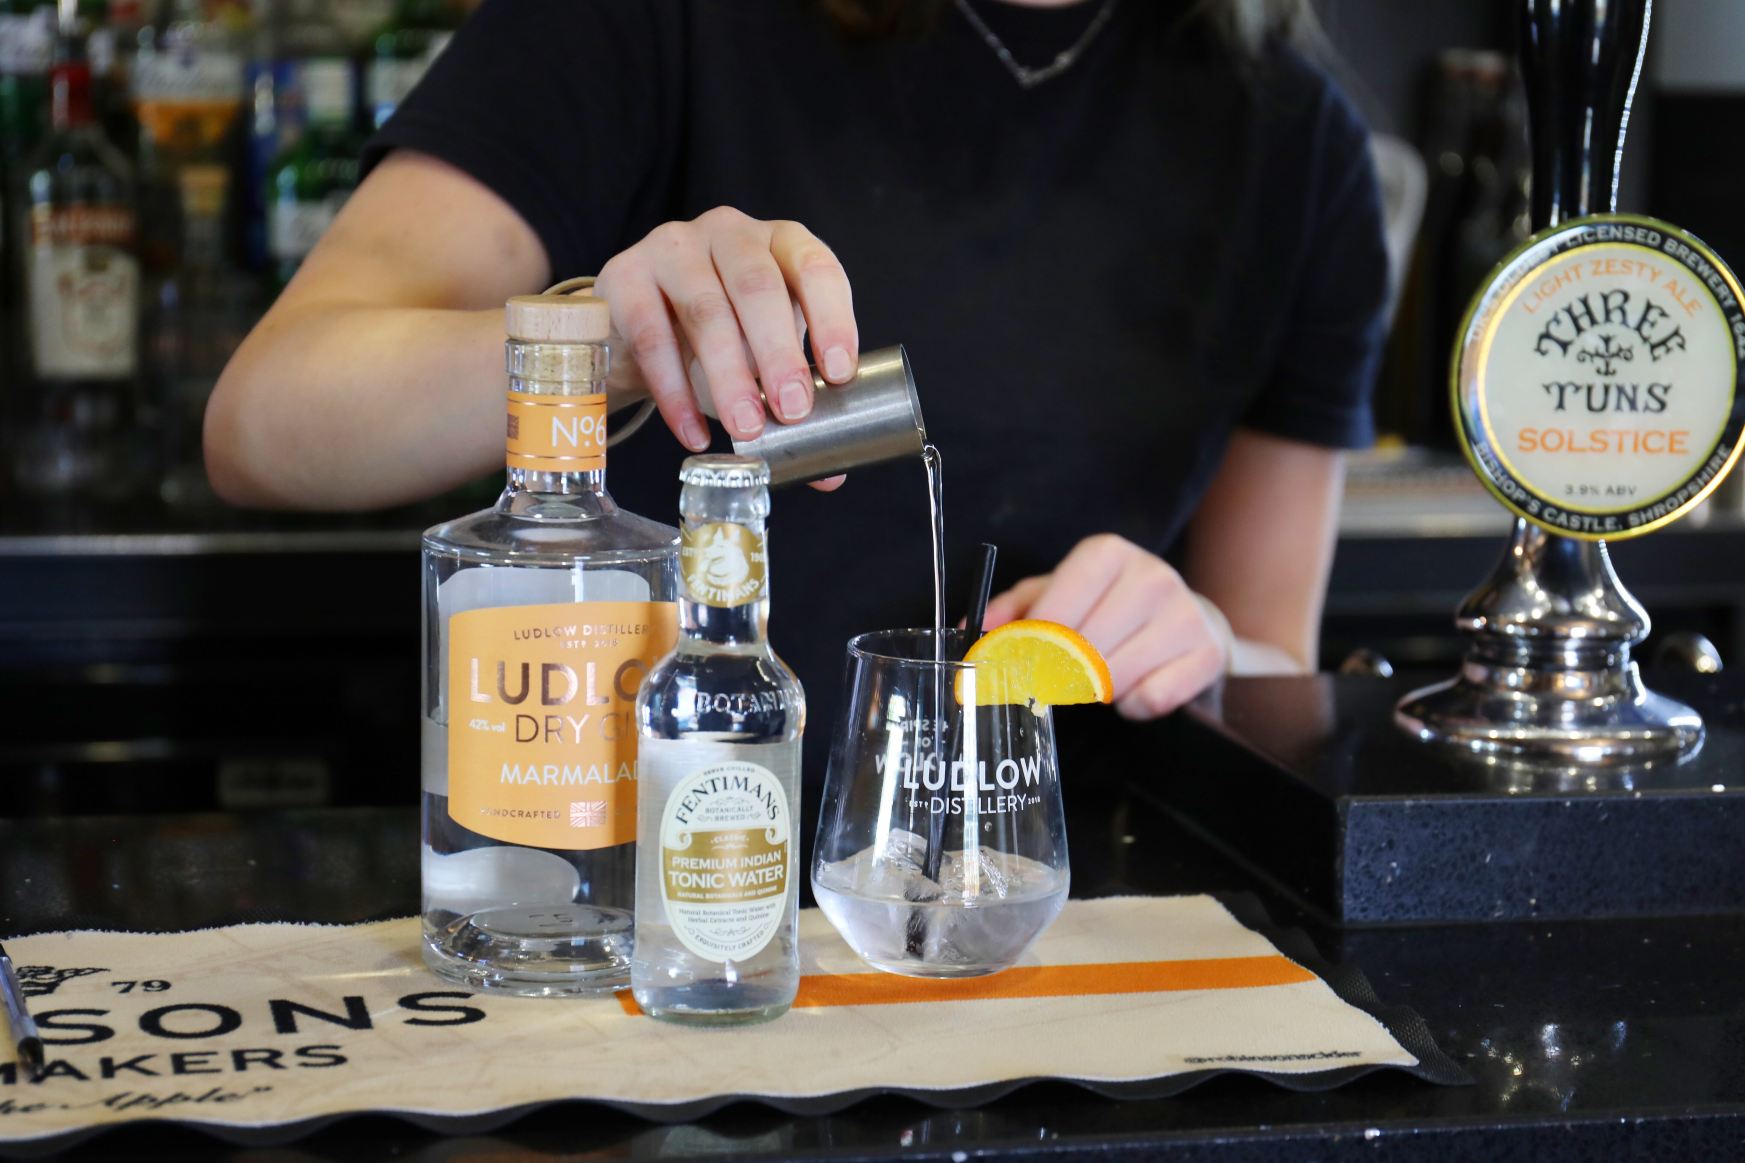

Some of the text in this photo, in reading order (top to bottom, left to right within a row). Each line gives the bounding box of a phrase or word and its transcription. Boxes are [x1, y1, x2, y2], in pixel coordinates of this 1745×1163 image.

[1566, 226, 1661, 248] LICENSED
[1664, 238, 1736, 307] BREWERY
[1522, 258, 1704, 318] LIGHT ZESTY ALE
[1534, 289, 1687, 362] THREE
[1542, 381, 1672, 413] TUNS
[1518, 427, 1689, 455] SOLSTICE
[1475, 442, 1541, 514] BISHOP'S
[1628, 444, 1732, 526] SHROPSHIRE
[1565, 484, 1638, 497] 3.9% ABV
[514, 624, 577, 641] LUDLOW
[471, 656, 656, 706] LUDLO
[490, 720, 507, 734] vol
[515, 713, 589, 744] DRY
[479, 806, 561, 820] HANDCRAFTED
[675, 775, 780, 825] FENTIMANS
[705, 805, 753, 815] BOTANICALLY
[671, 850, 781, 870] PREMIUM INDIAN
[667, 864, 784, 889] TONIC WATER
[695, 934, 737, 952] EXQUISITELY
[111, 979, 173, 993] 79
[33, 990, 486, 1046] SONS
